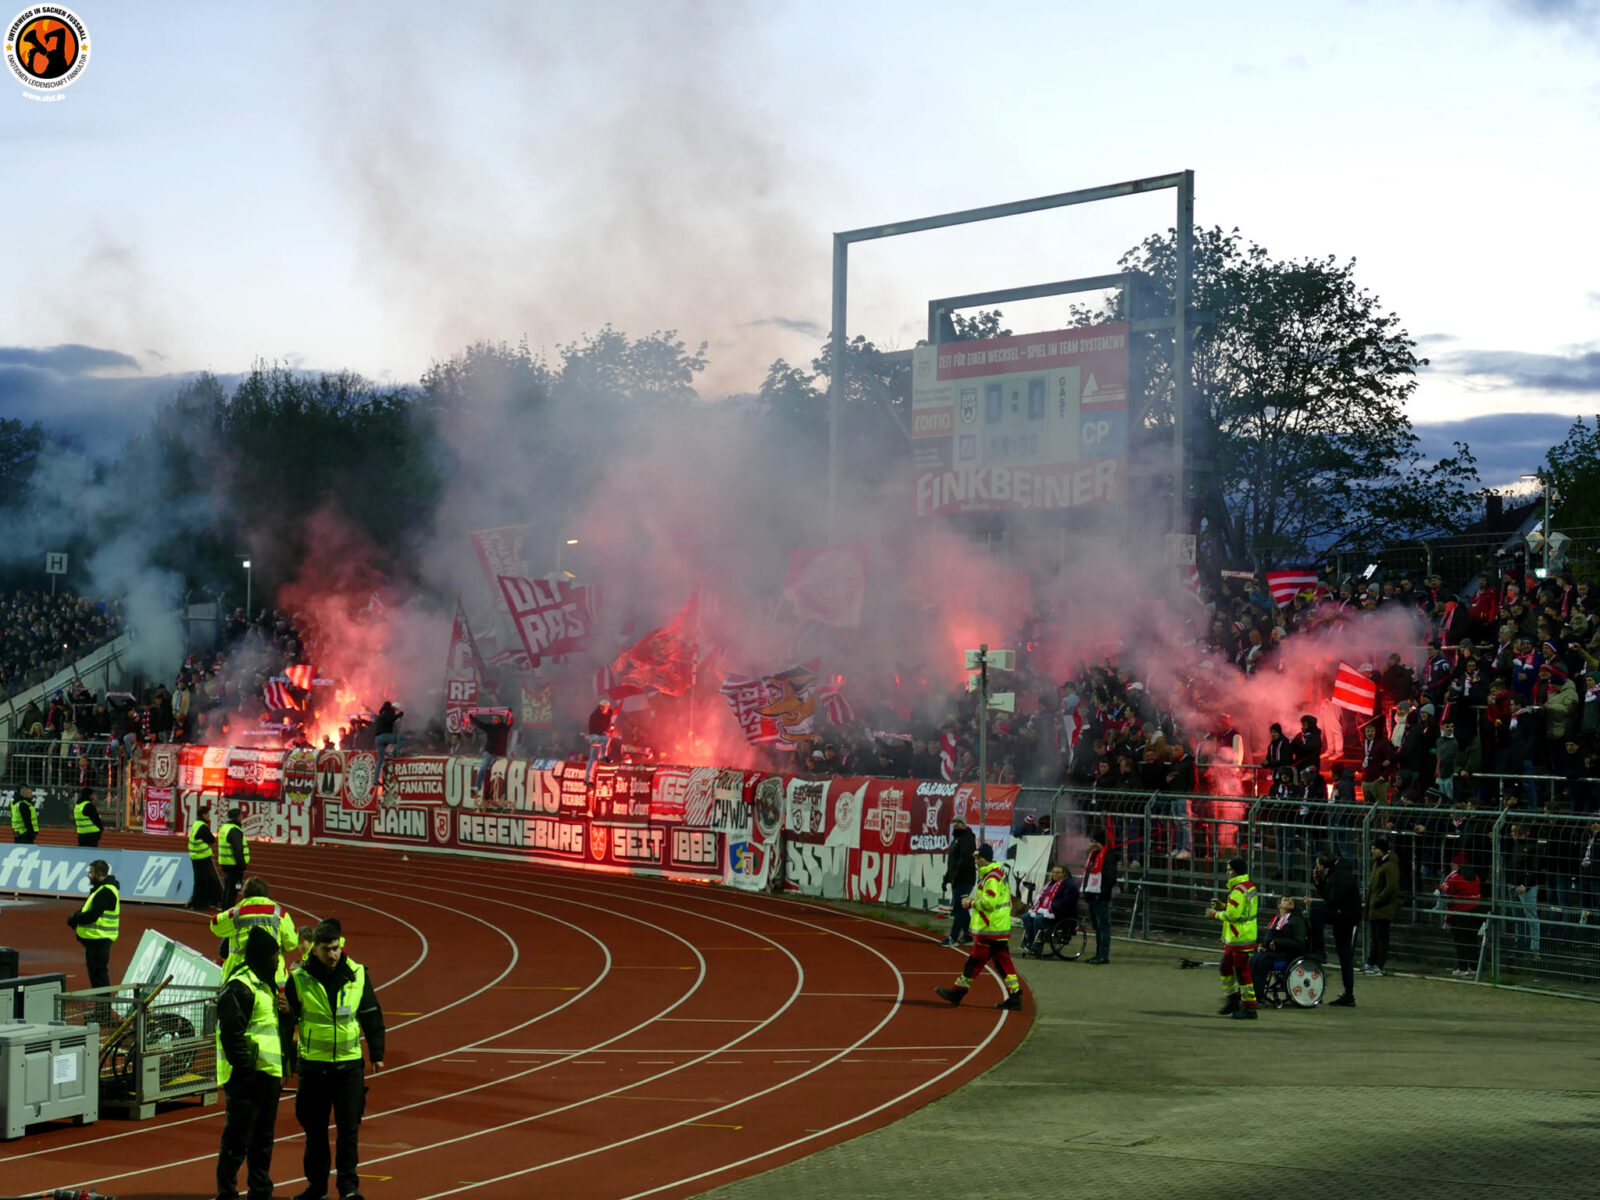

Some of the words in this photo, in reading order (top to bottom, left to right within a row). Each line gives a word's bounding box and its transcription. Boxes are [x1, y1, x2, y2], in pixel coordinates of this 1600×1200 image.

[987, 349, 1019, 364] WECHSEL
[1027, 345, 1046, 360] SPIEL
[1048, 343, 1058, 357] IM
[1059, 339, 1079, 354] TEAM
[1058, 376, 1067, 420] GAST
[914, 412, 950, 431] roma
[916, 460, 1118, 517] FINKBEINER
[51, 556, 63, 571] H
[450, 682, 476, 700] RF
[395, 762, 444, 775] RATISBONA
[399, 780, 444, 794] FANATICA
[325, 803, 366, 833] SSV
[374, 807, 426, 837] JAHN
[459, 814, 583, 853] REGENSBURG
[614, 828, 664, 858] SEIT
[673, 830, 716, 863] 1889
